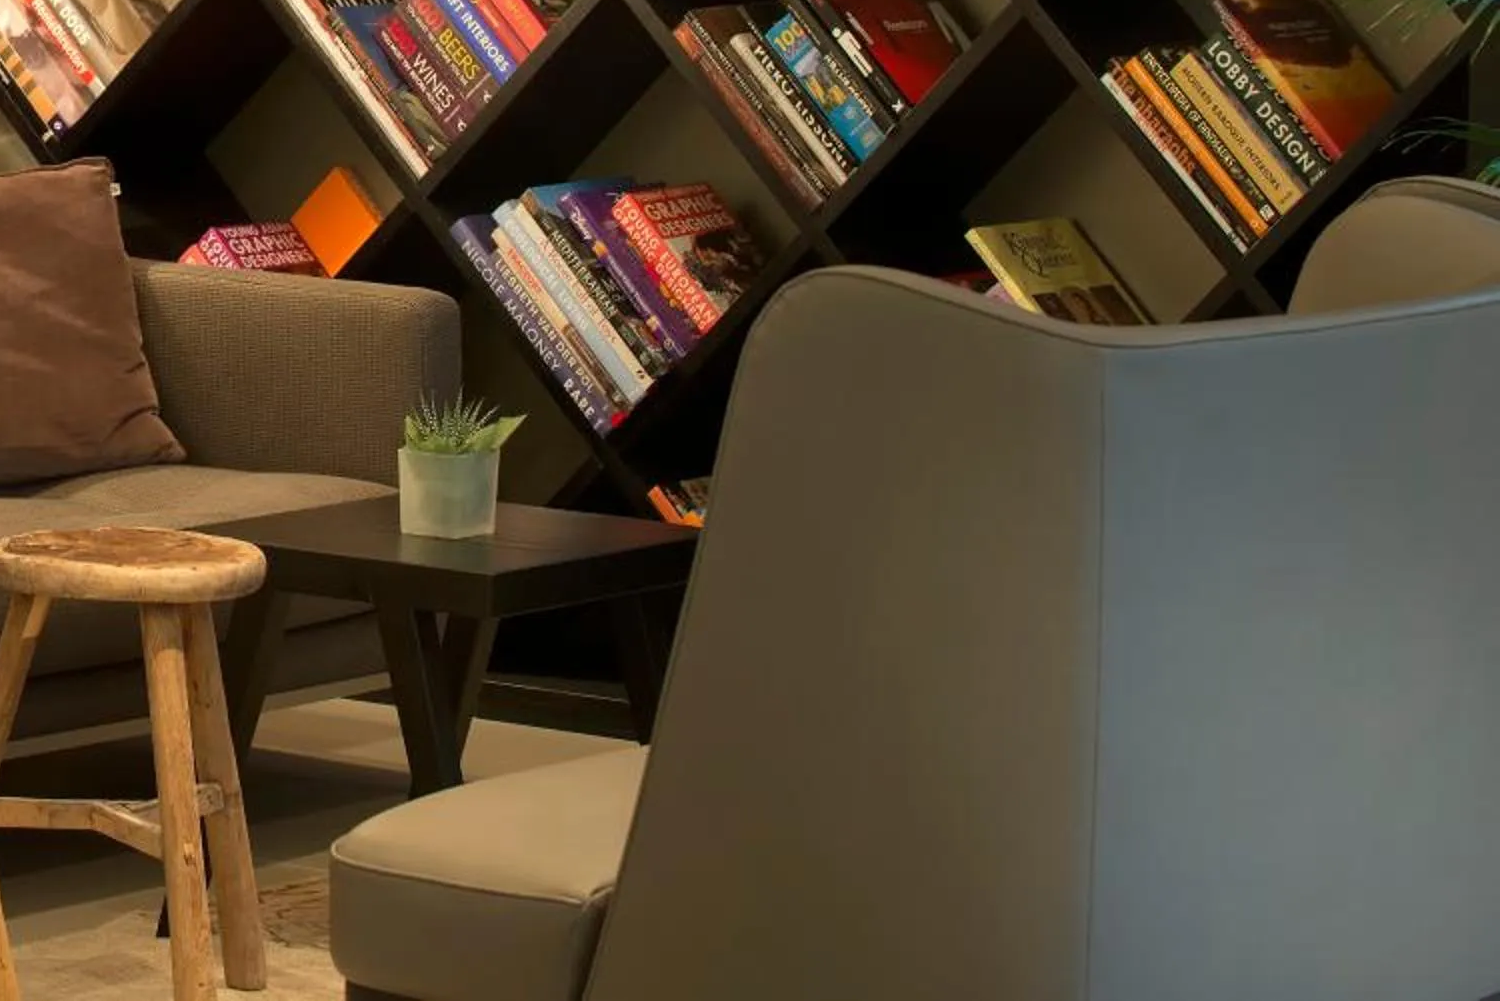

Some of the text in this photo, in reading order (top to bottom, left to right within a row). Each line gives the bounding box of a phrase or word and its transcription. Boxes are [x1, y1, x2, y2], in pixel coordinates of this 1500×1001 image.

[58, 4, 91, 47] DOGS
[434, 26, 484, 81] BEERS
[458, 11, 513, 73] INTERIORS
[407, 51, 457, 109] WINES
[1203, 40, 1319, 173] LOBBY DESIGN
[645, 192, 723, 221] GRAPHIC
[230, 231, 307, 254] GRAPHIC
[619, 197, 716, 324] YOUNG EUROPEAN
[458, 239, 506, 297] NICOLE
[501, 297, 562, 372] MALONEY
[560, 377, 596, 420] RARE
[535, 314, 559, 340] VAN
[553, 337, 579, 367] DER
[573, 363, 598, 391] POL
